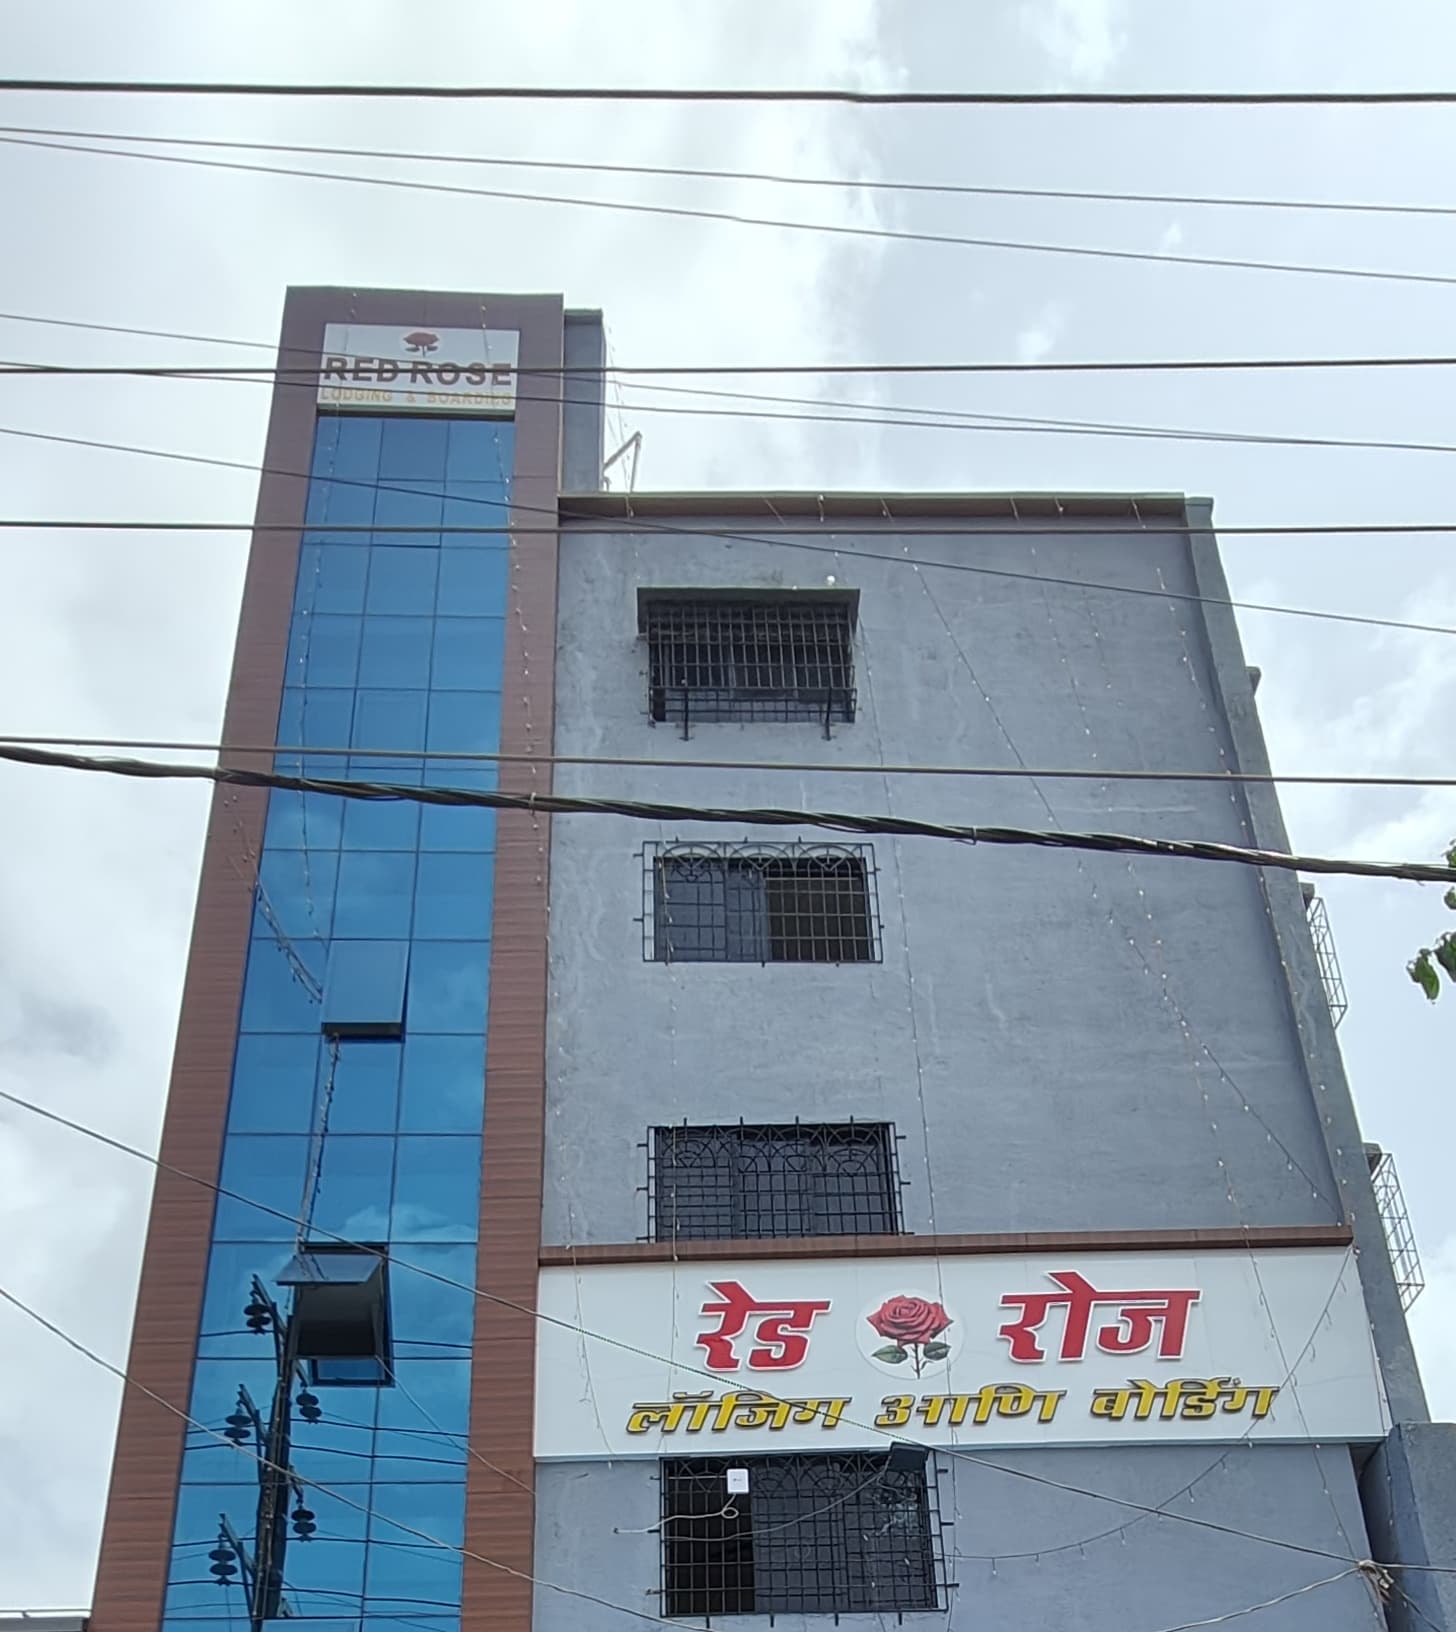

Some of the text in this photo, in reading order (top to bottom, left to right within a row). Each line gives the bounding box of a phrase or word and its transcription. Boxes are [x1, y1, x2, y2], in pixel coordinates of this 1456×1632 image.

[323, 356, 512, 386] RED ROSE
[696, 1271, 1201, 1372] रेड रोज
[875, 1384, 1067, 1430] आणि
